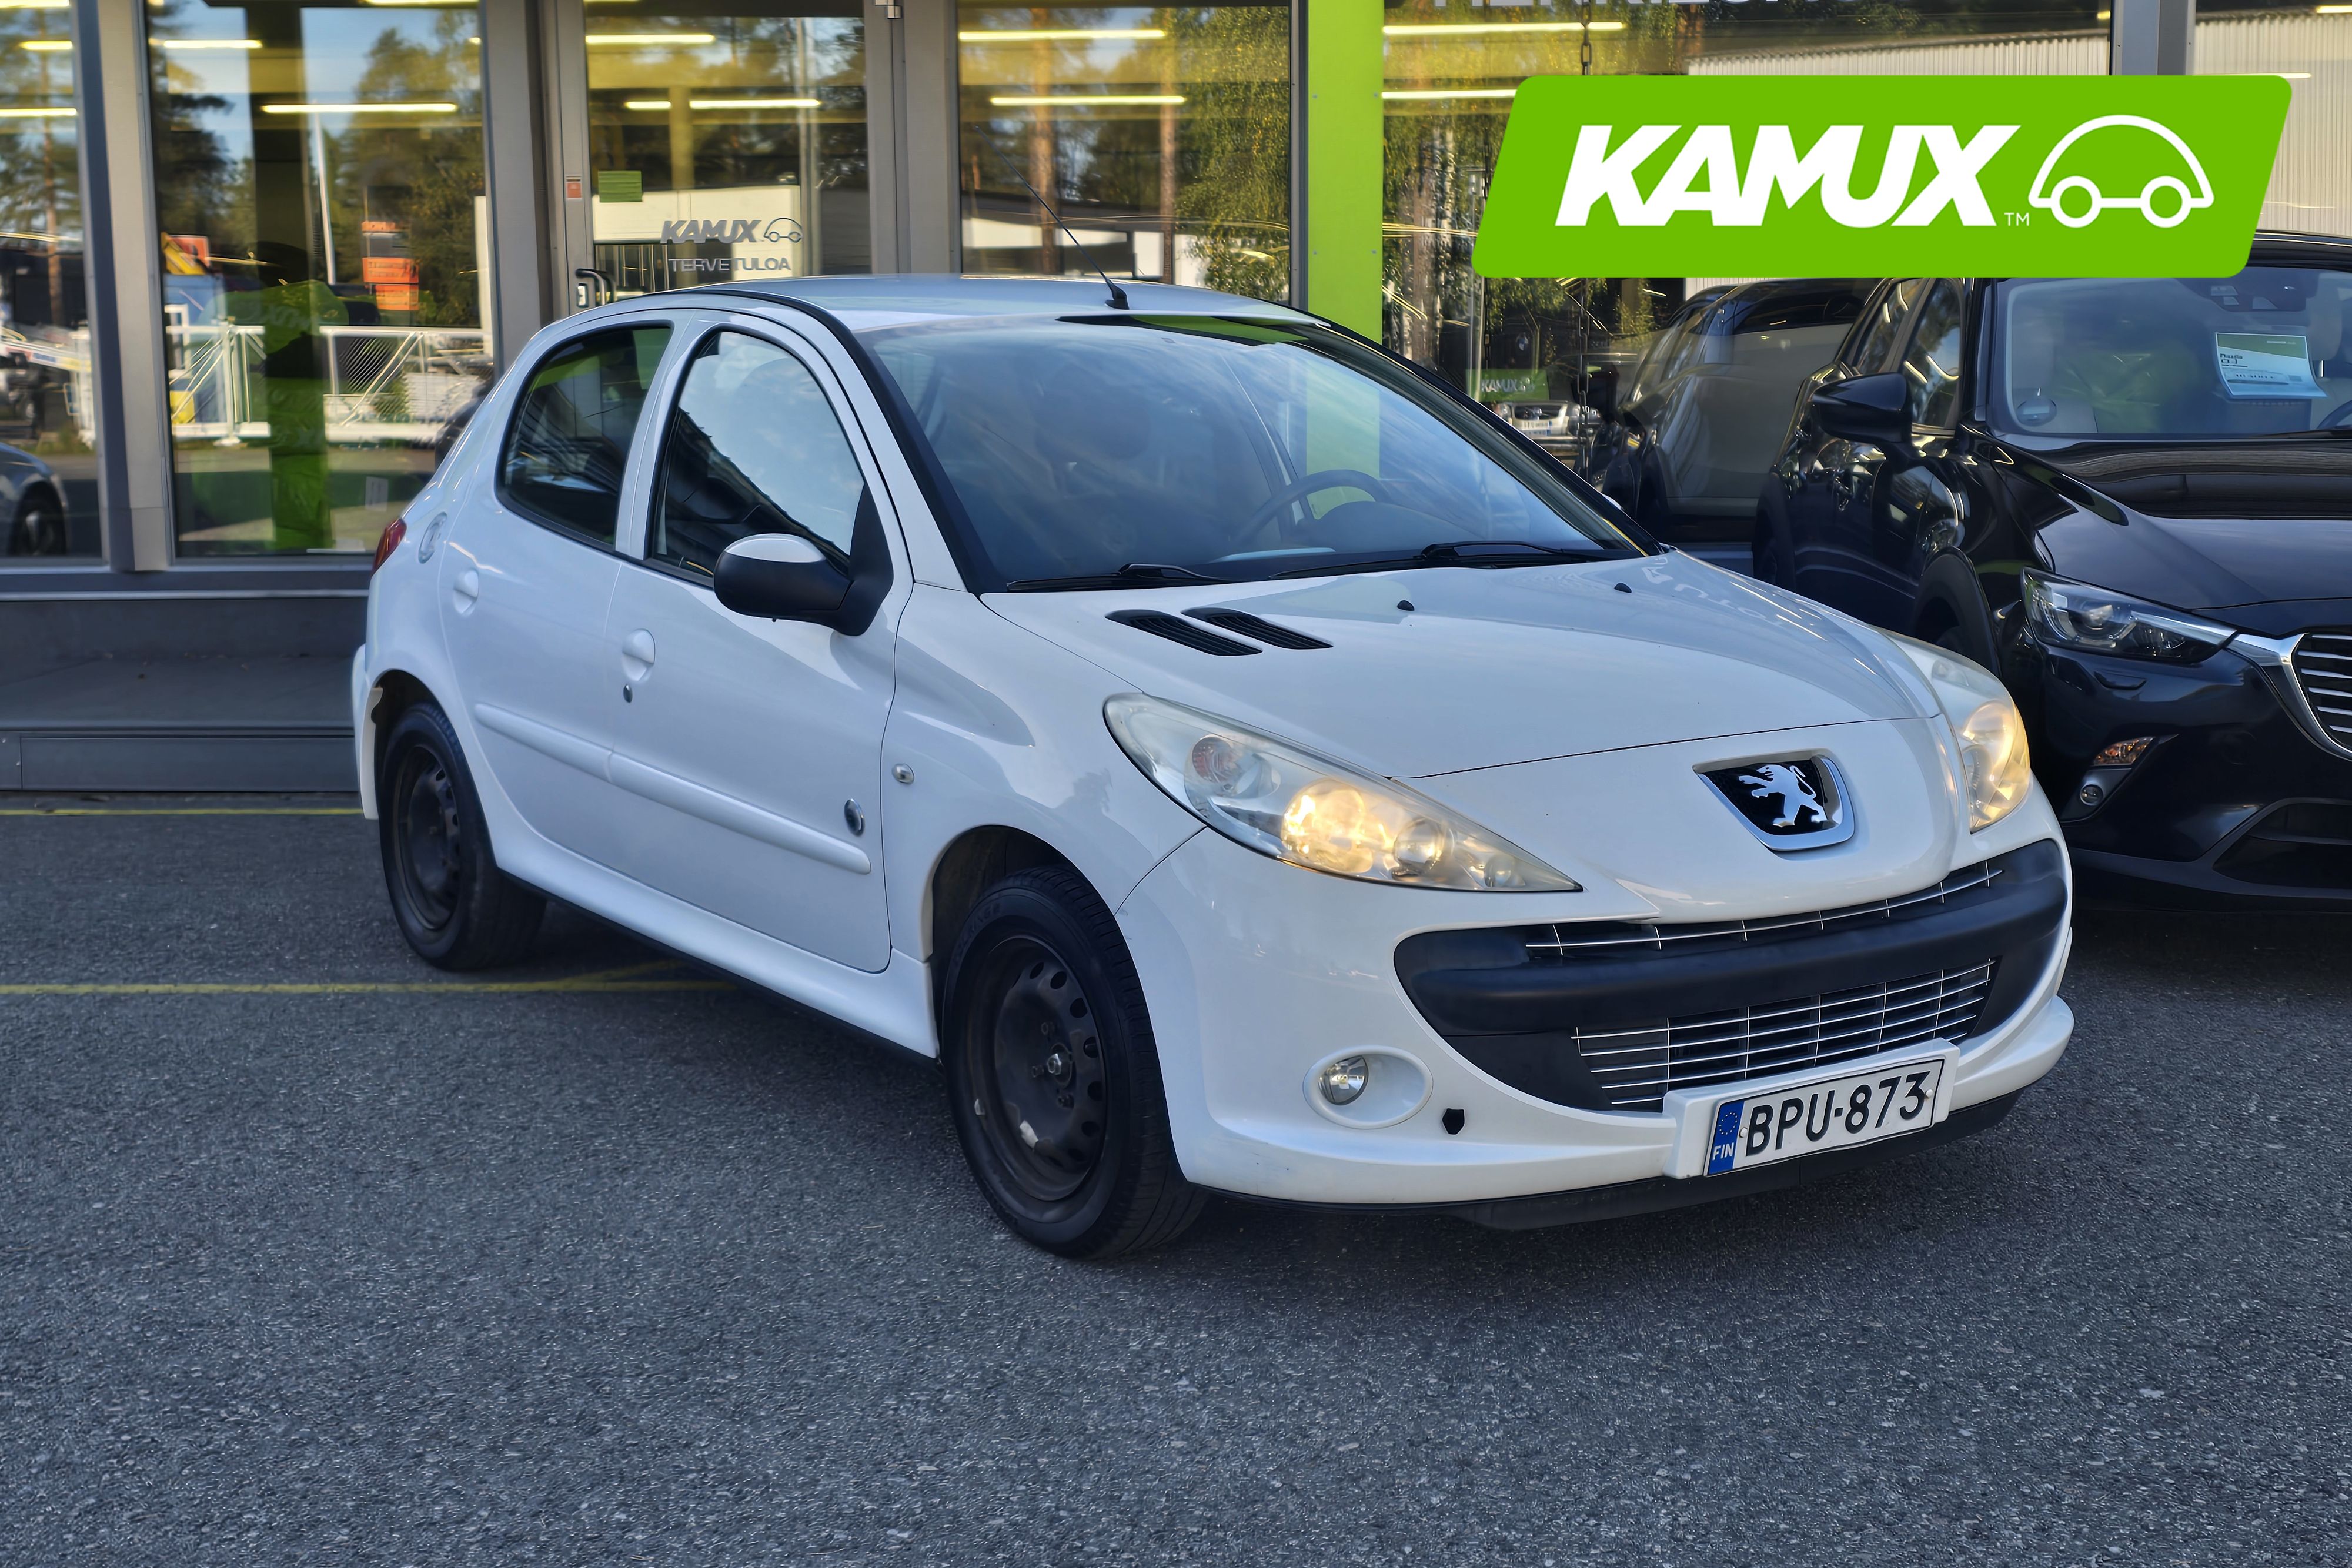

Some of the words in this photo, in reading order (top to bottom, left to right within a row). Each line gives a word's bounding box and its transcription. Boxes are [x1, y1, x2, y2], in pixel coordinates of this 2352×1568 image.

[660, 220, 762, 243] KAMUX
[668, 258, 791, 272] TERVETULOA
[1746, 1071, 1930, 1157] BPU-873
[1712, 1142, 1735, 1161] FIN
